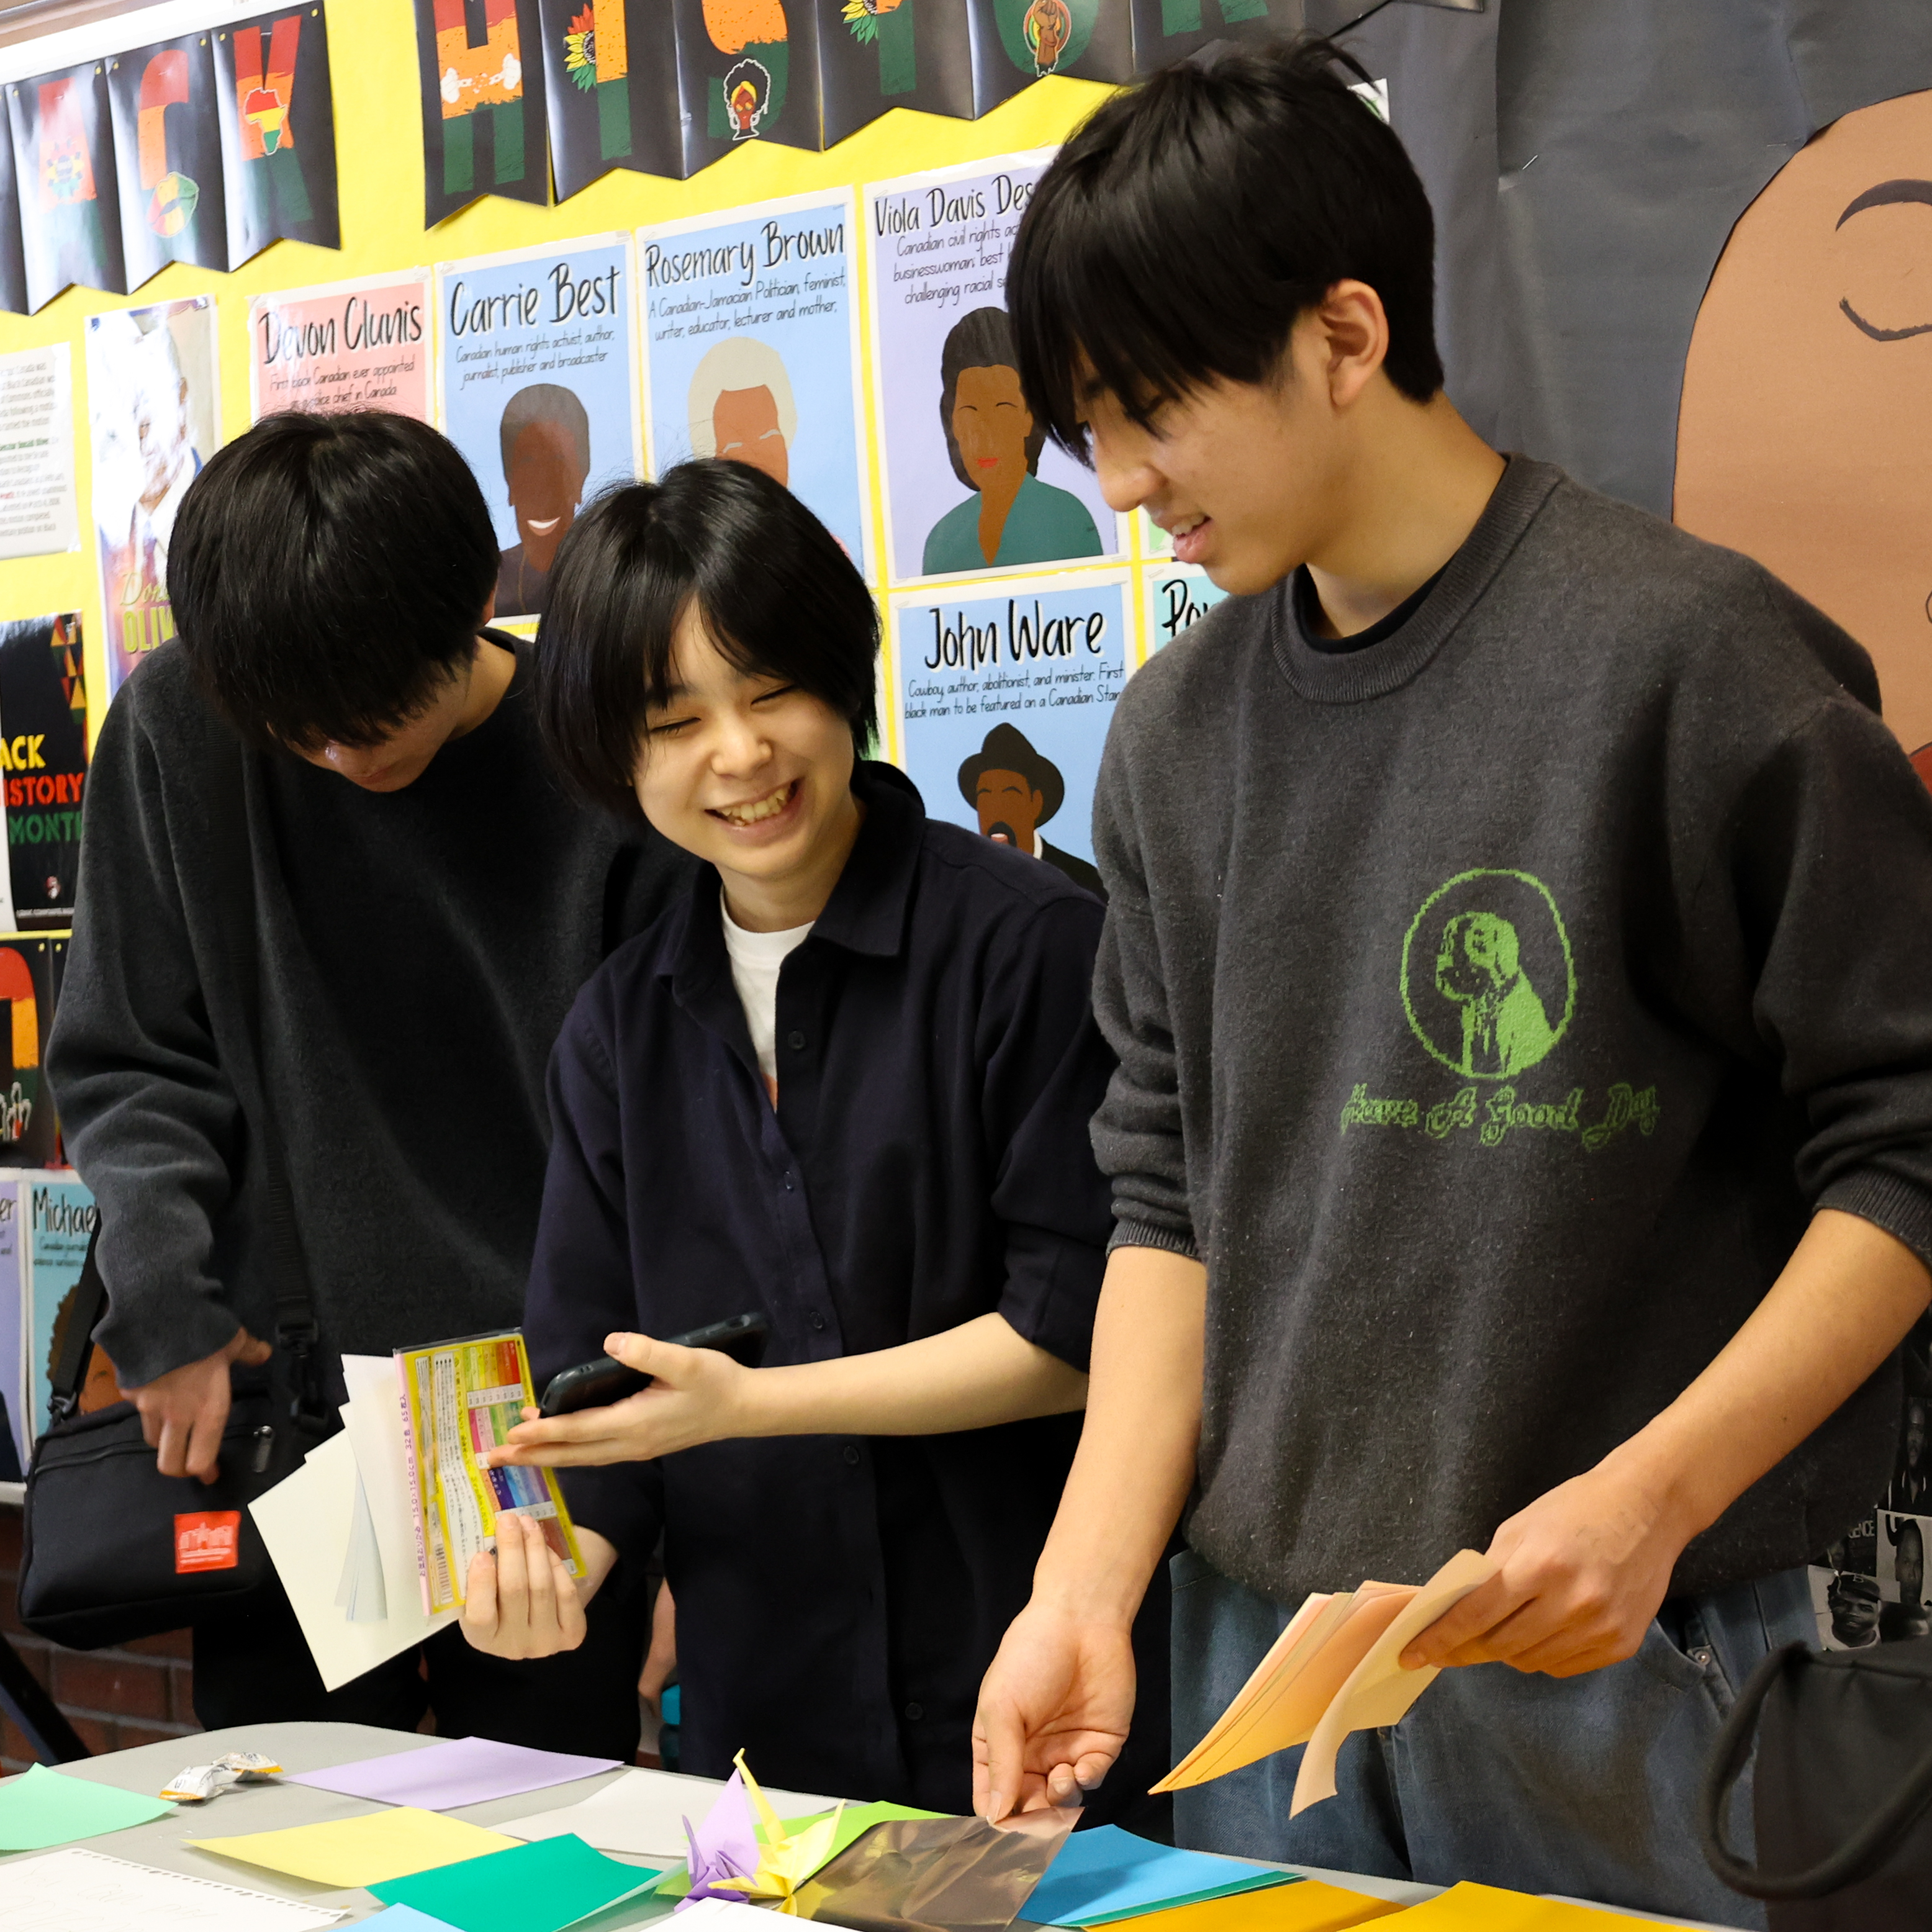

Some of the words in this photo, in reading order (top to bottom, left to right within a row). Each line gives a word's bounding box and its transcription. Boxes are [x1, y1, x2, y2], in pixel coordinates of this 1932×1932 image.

[875, 197, 920, 237] Viola
[926, 187, 986, 228] Davis
[645, 242, 754, 287] Rosemary
[761, 220, 844, 268] Brown
[897, 231, 944, 256] Canadian
[948, 225, 966, 246] civil
[969, 220, 1001, 251] rights
[980, 243, 1004, 266] best
[451, 282, 538, 336] Carrie
[548, 263, 621, 322] Best
[905, 281, 960, 308] challenging
[964, 269, 994, 293] racial
[648, 300, 657, 319] A
[733, 306, 773, 327] lecturer
[777, 299, 796, 320] and
[258, 310, 335, 364] Devon
[344, 296, 422, 350] Clunis
[456, 343, 492, 363] Canadian
[495, 341, 523, 356] human
[526, 333, 550, 359] rights
[373, 354, 415, 384] appointed
[500, 358, 538, 384] publisher
[539, 352, 556, 371] and
[557, 346, 608, 368] broadcaster
[924, 608, 999, 670] John
[1008, 599, 1103, 662] Ware
[947, 675, 979, 693] author,
[982, 669, 1031, 692] abolitionist,
[1034, 667, 1053, 687] and
[1055, 664, 1095, 682] minister.
[1099, 660, 1124, 680] First
[905, 701, 926, 719] black
[929, 706, 950, 716] man
[954, 697, 963, 715] to
[966, 697, 977, 714] be
[980, 692, 1022, 713] featured
[1024, 698, 1036, 708] on
[1039, 698, 1045, 707] a
[1049, 687, 1093, 706] Canadian
[1479, 1084, 1584, 1147] Good
[34, 1186, 97, 1237] Michae
